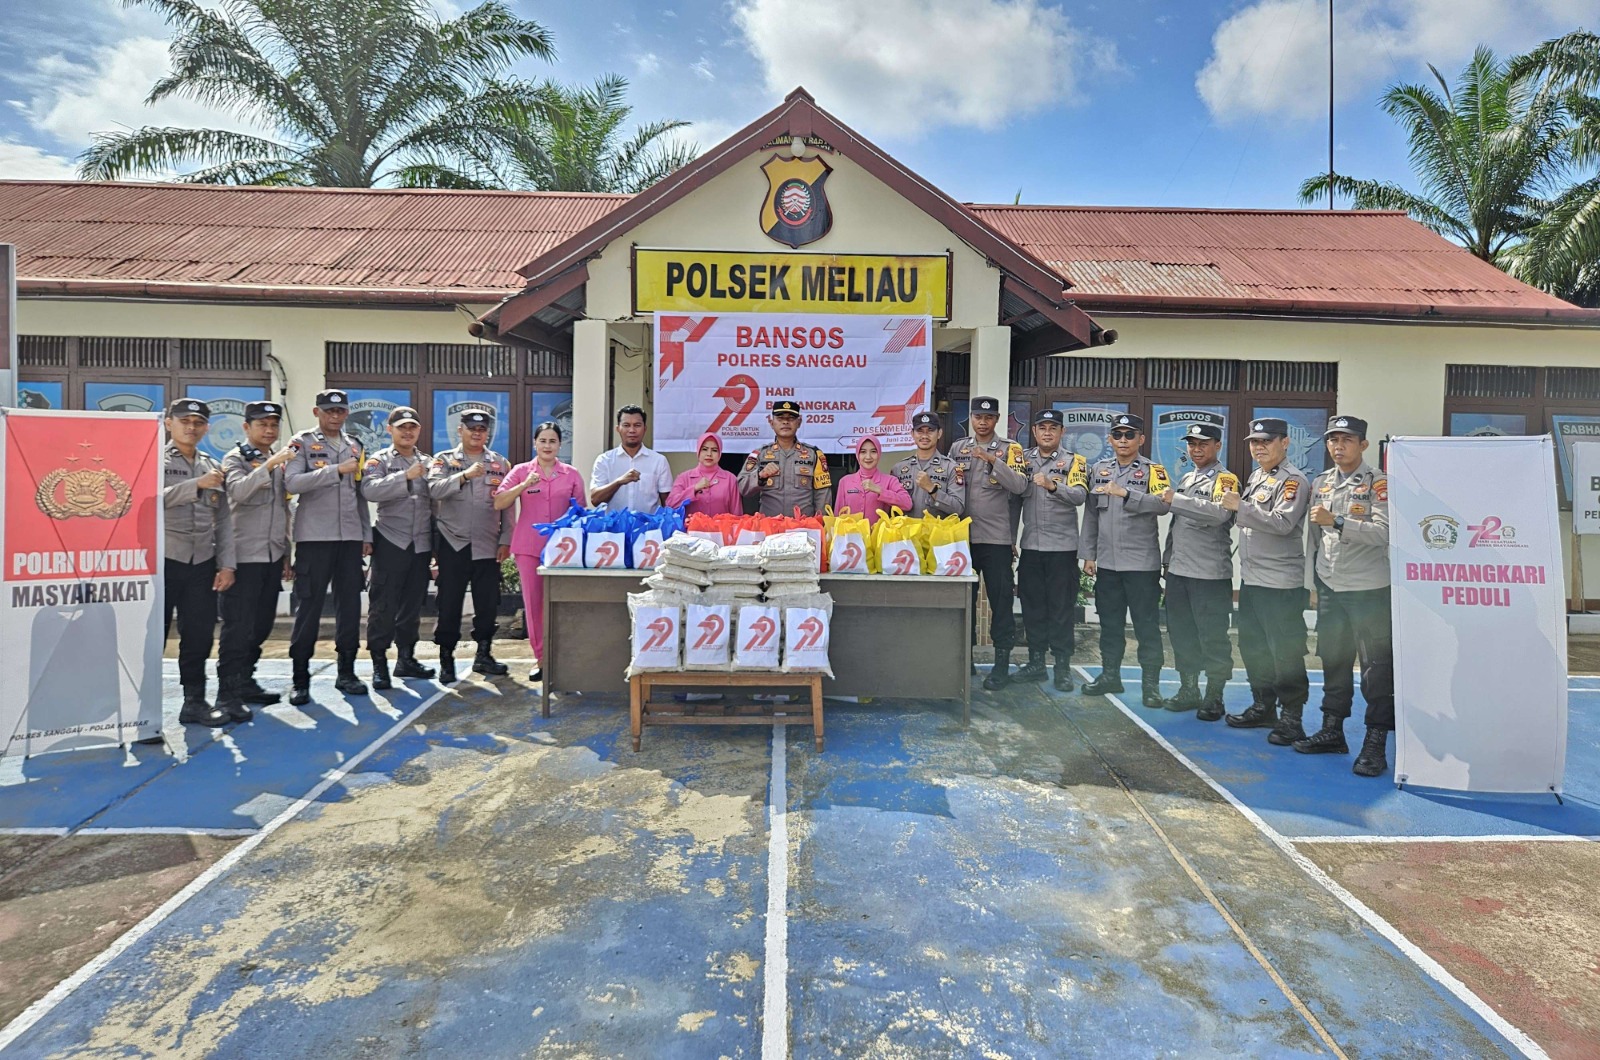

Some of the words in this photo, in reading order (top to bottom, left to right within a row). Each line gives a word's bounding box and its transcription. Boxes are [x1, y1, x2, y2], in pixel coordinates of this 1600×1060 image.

[666, 262, 791, 300] POLSEK
[801, 266, 918, 303] MELIAU
[736, 326, 845, 349] BANSOS
[717, 353, 781, 367] POLRES
[785, 354, 867, 368] SANGGAU
[765, 387, 795, 397] HARI
[452, 403, 492, 414] LOGISTIK
[765, 401, 857, 411] BANGKARA
[806, 414, 835, 424] 2025
[1068, 413, 1112, 423] BINMAS
[1169, 413, 1211, 422] PROVOS
[853, 425, 886, 434] POLSEK
[888, 424, 913, 432] MELIA
[13, 551, 75, 576] POLRI
[79, 549, 148, 573] UNTUK
[1405, 562, 1546, 585] BHAYANGKARI
[11, 580, 149, 608] MASYARAKAT
[1441, 586, 1511, 607] PEDULI
[10, 731, 41, 742] POLRES
[43, 726, 83, 738] SANGGAU
[89, 723, 115, 732] POLDA
